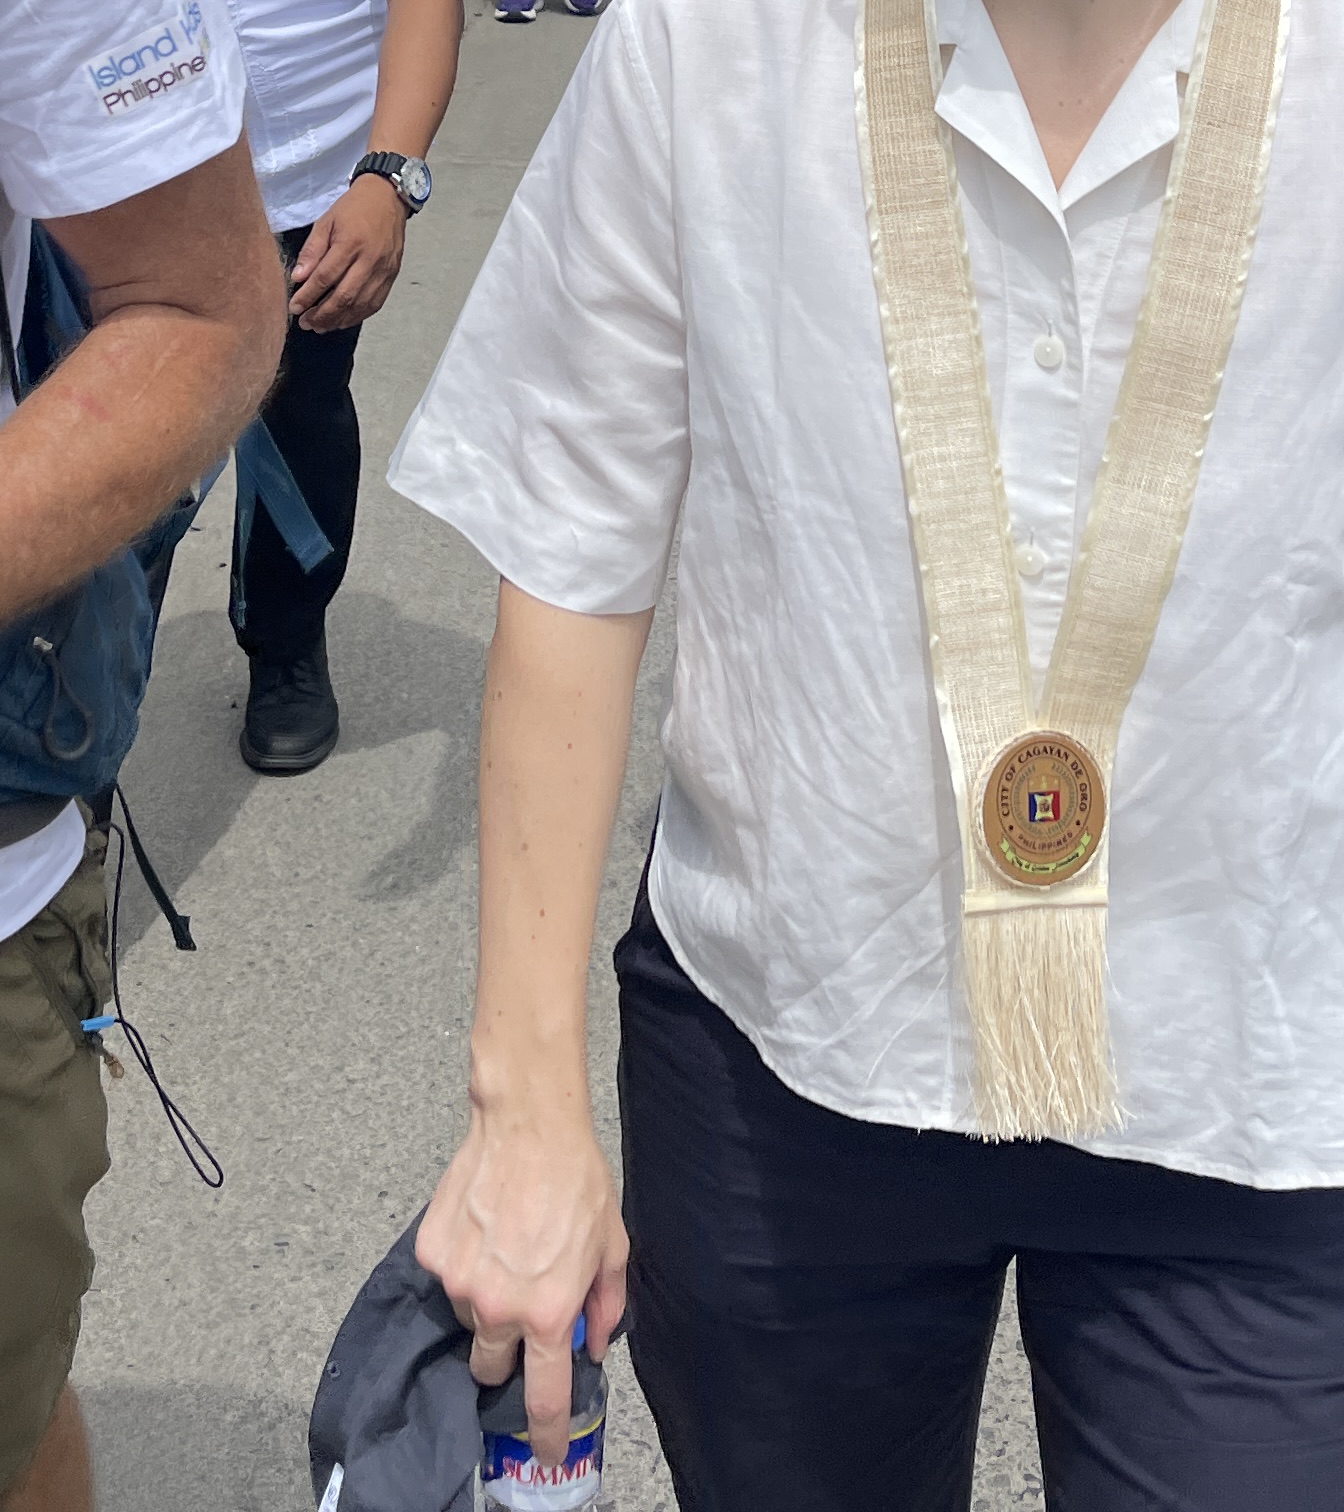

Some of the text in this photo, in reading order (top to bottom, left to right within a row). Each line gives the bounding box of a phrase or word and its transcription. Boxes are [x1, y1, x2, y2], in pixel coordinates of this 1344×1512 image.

[88, 27, 179, 90] Island
[1000, 745, 1088, 817] CITY OF CAGAYAN DE ORO
[1017, 831, 1074, 851] PHILIPPINES
